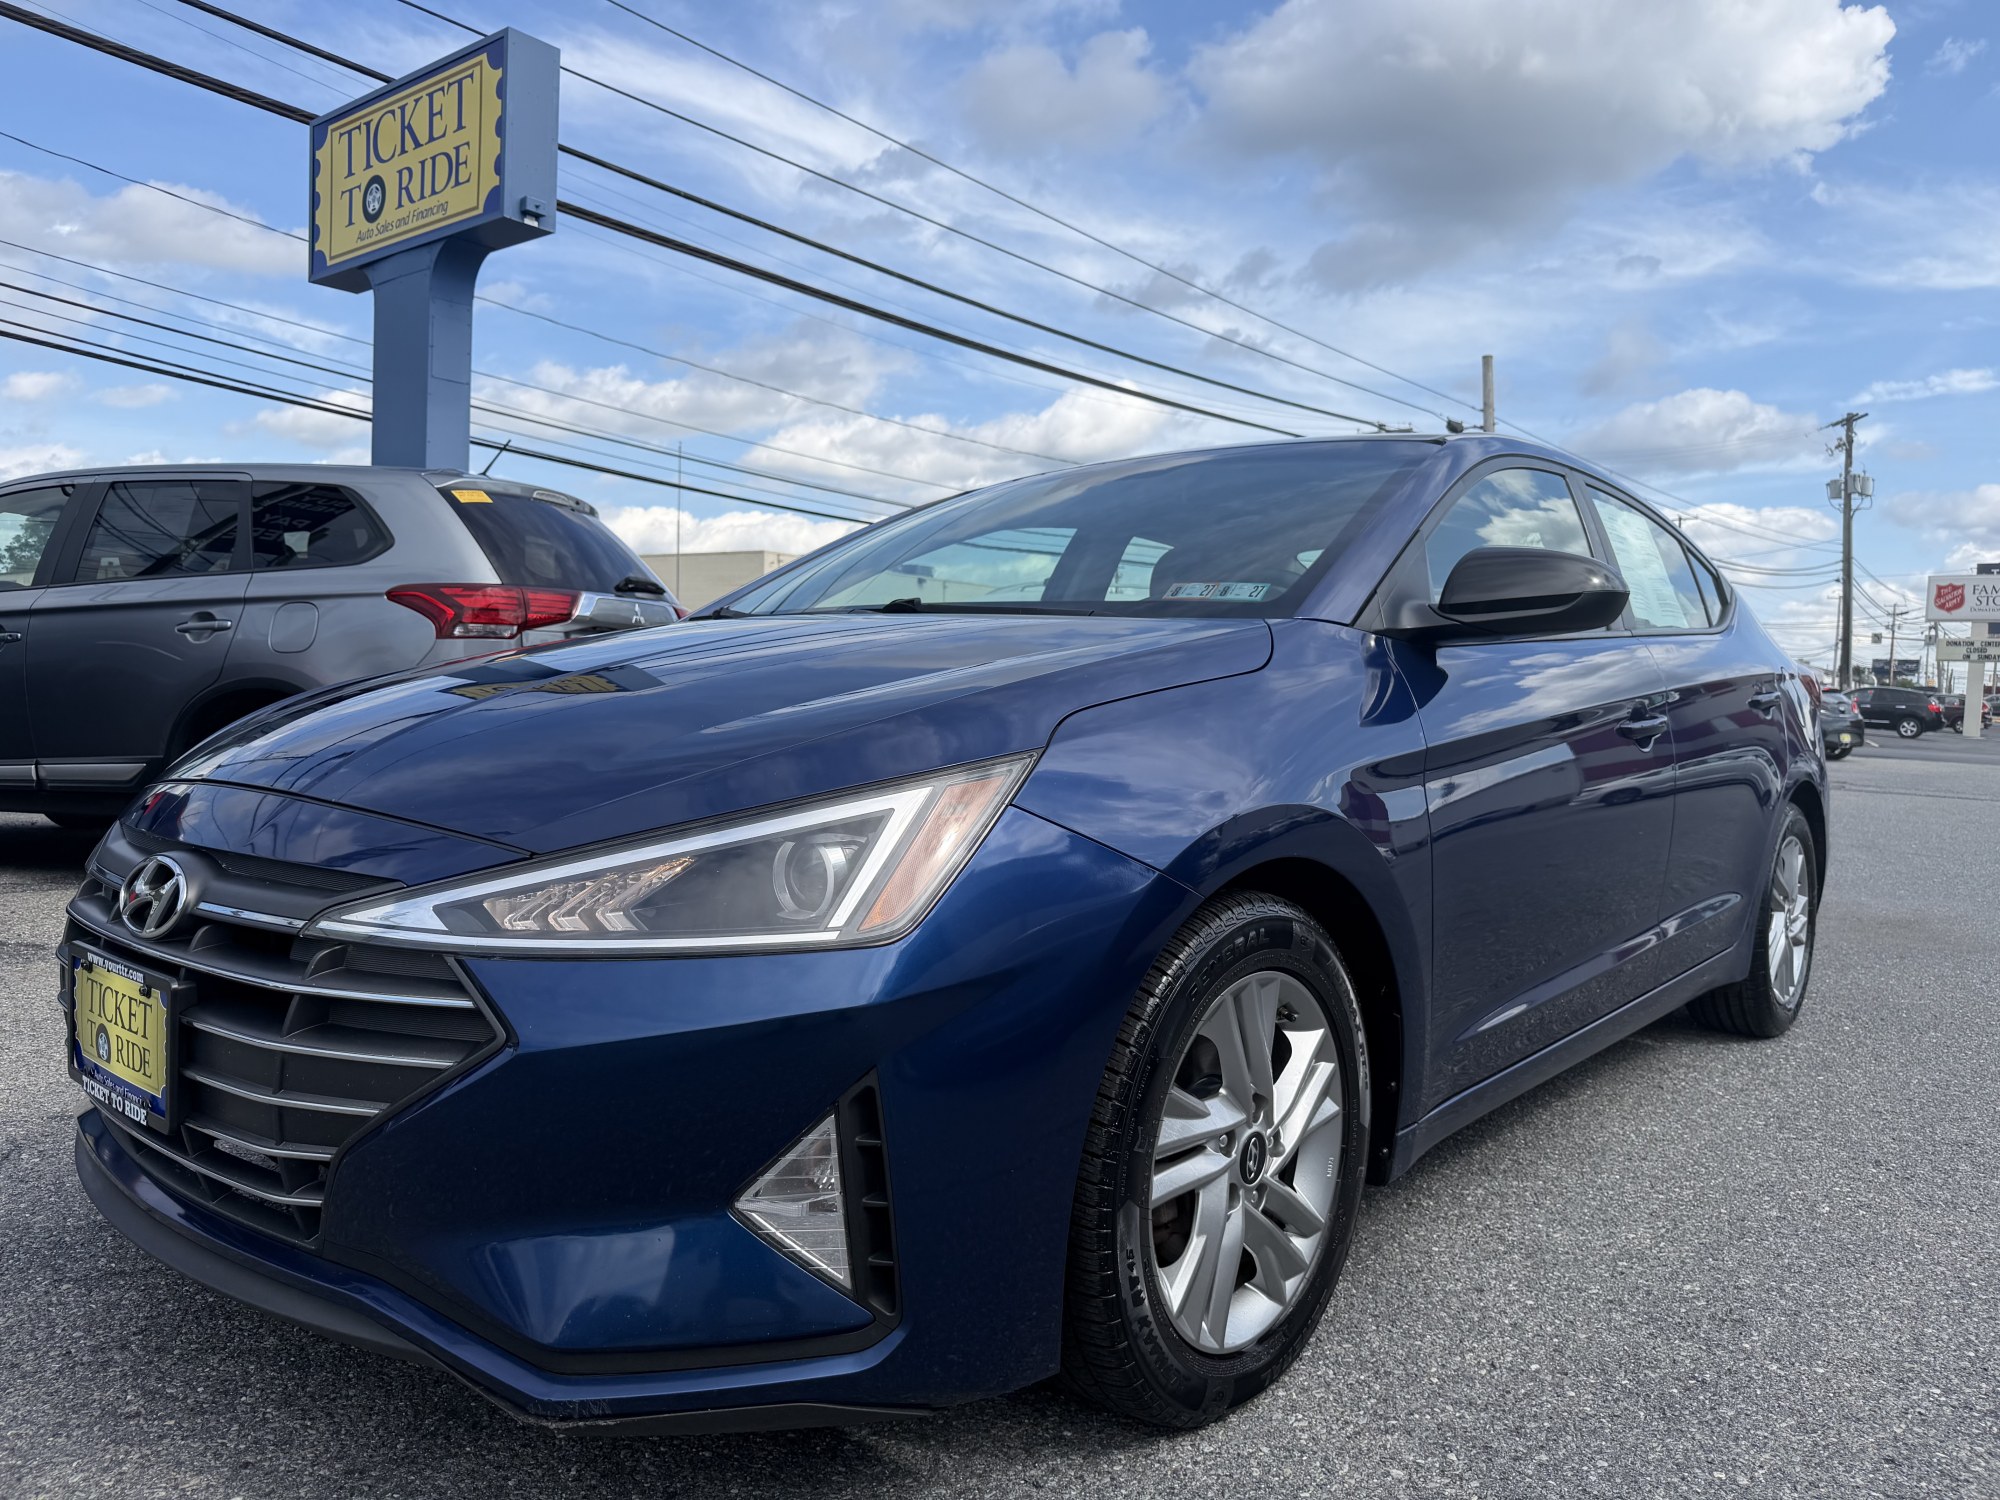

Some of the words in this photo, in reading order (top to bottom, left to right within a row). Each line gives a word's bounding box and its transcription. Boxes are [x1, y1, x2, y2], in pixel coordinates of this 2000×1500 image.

[338, 70, 474, 180] TICKET
[340, 174, 387, 228] TO
[395, 141, 472, 210] RIDE
[355, 228, 374, 243] Auto
[375, 220, 395, 237] Sales
[395, 211, 411, 229] and
[411, 200, 449, 223] Financing
[1200, 585, 1216, 597] 27
[1248, 585, 1265, 598] 27
[87, 952, 144, 983] www.yourttr.com
[86, 977, 153, 1040] TICKET
[86, 1018, 112, 1064] TO
[115, 1034, 152, 1079] RIDE
[82, 1075, 110, 1104] TICKET
[110, 1092, 123, 1112] TO
[124, 1100, 147, 1126] RIDE
